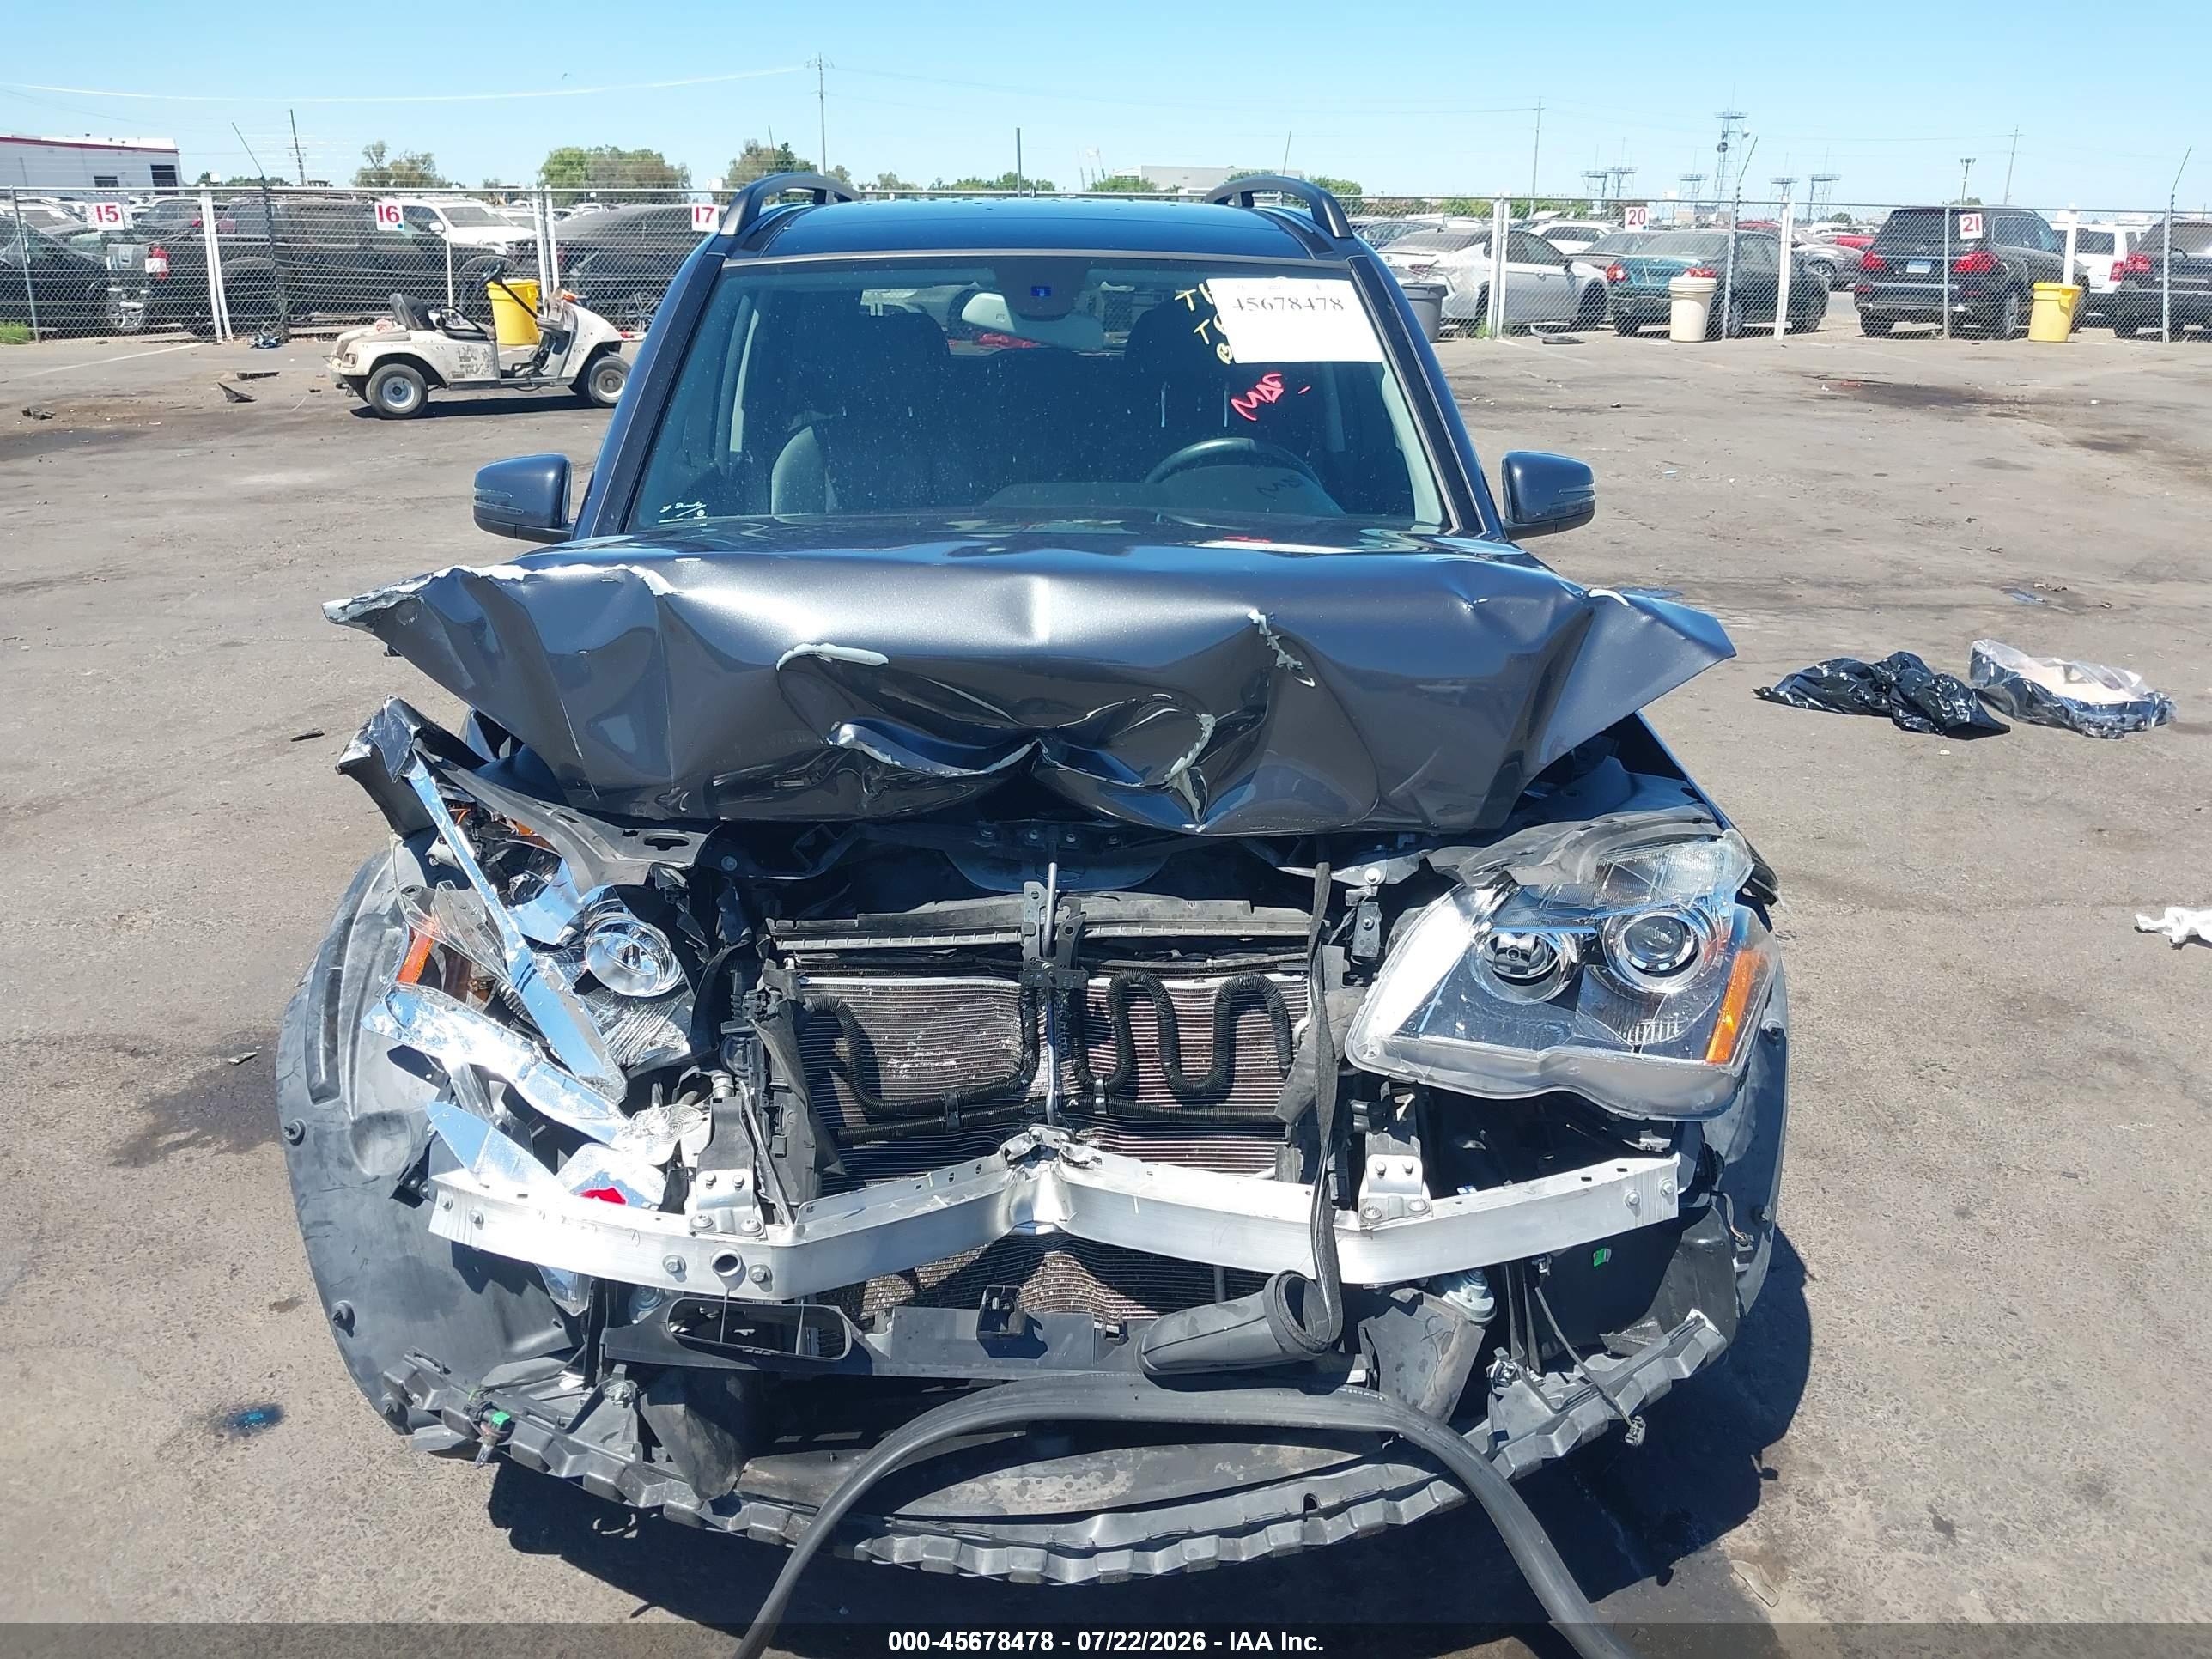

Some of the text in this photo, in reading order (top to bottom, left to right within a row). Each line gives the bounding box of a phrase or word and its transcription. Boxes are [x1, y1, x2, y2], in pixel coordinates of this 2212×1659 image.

[95, 205, 119, 223] 15
[378, 204, 400, 223] 16
[695, 206, 714, 223] 17
[1628, 208, 1646, 225] 20
[1962, 216, 1980, 232] 21
[1231, 296, 1346, 312] 45678478
